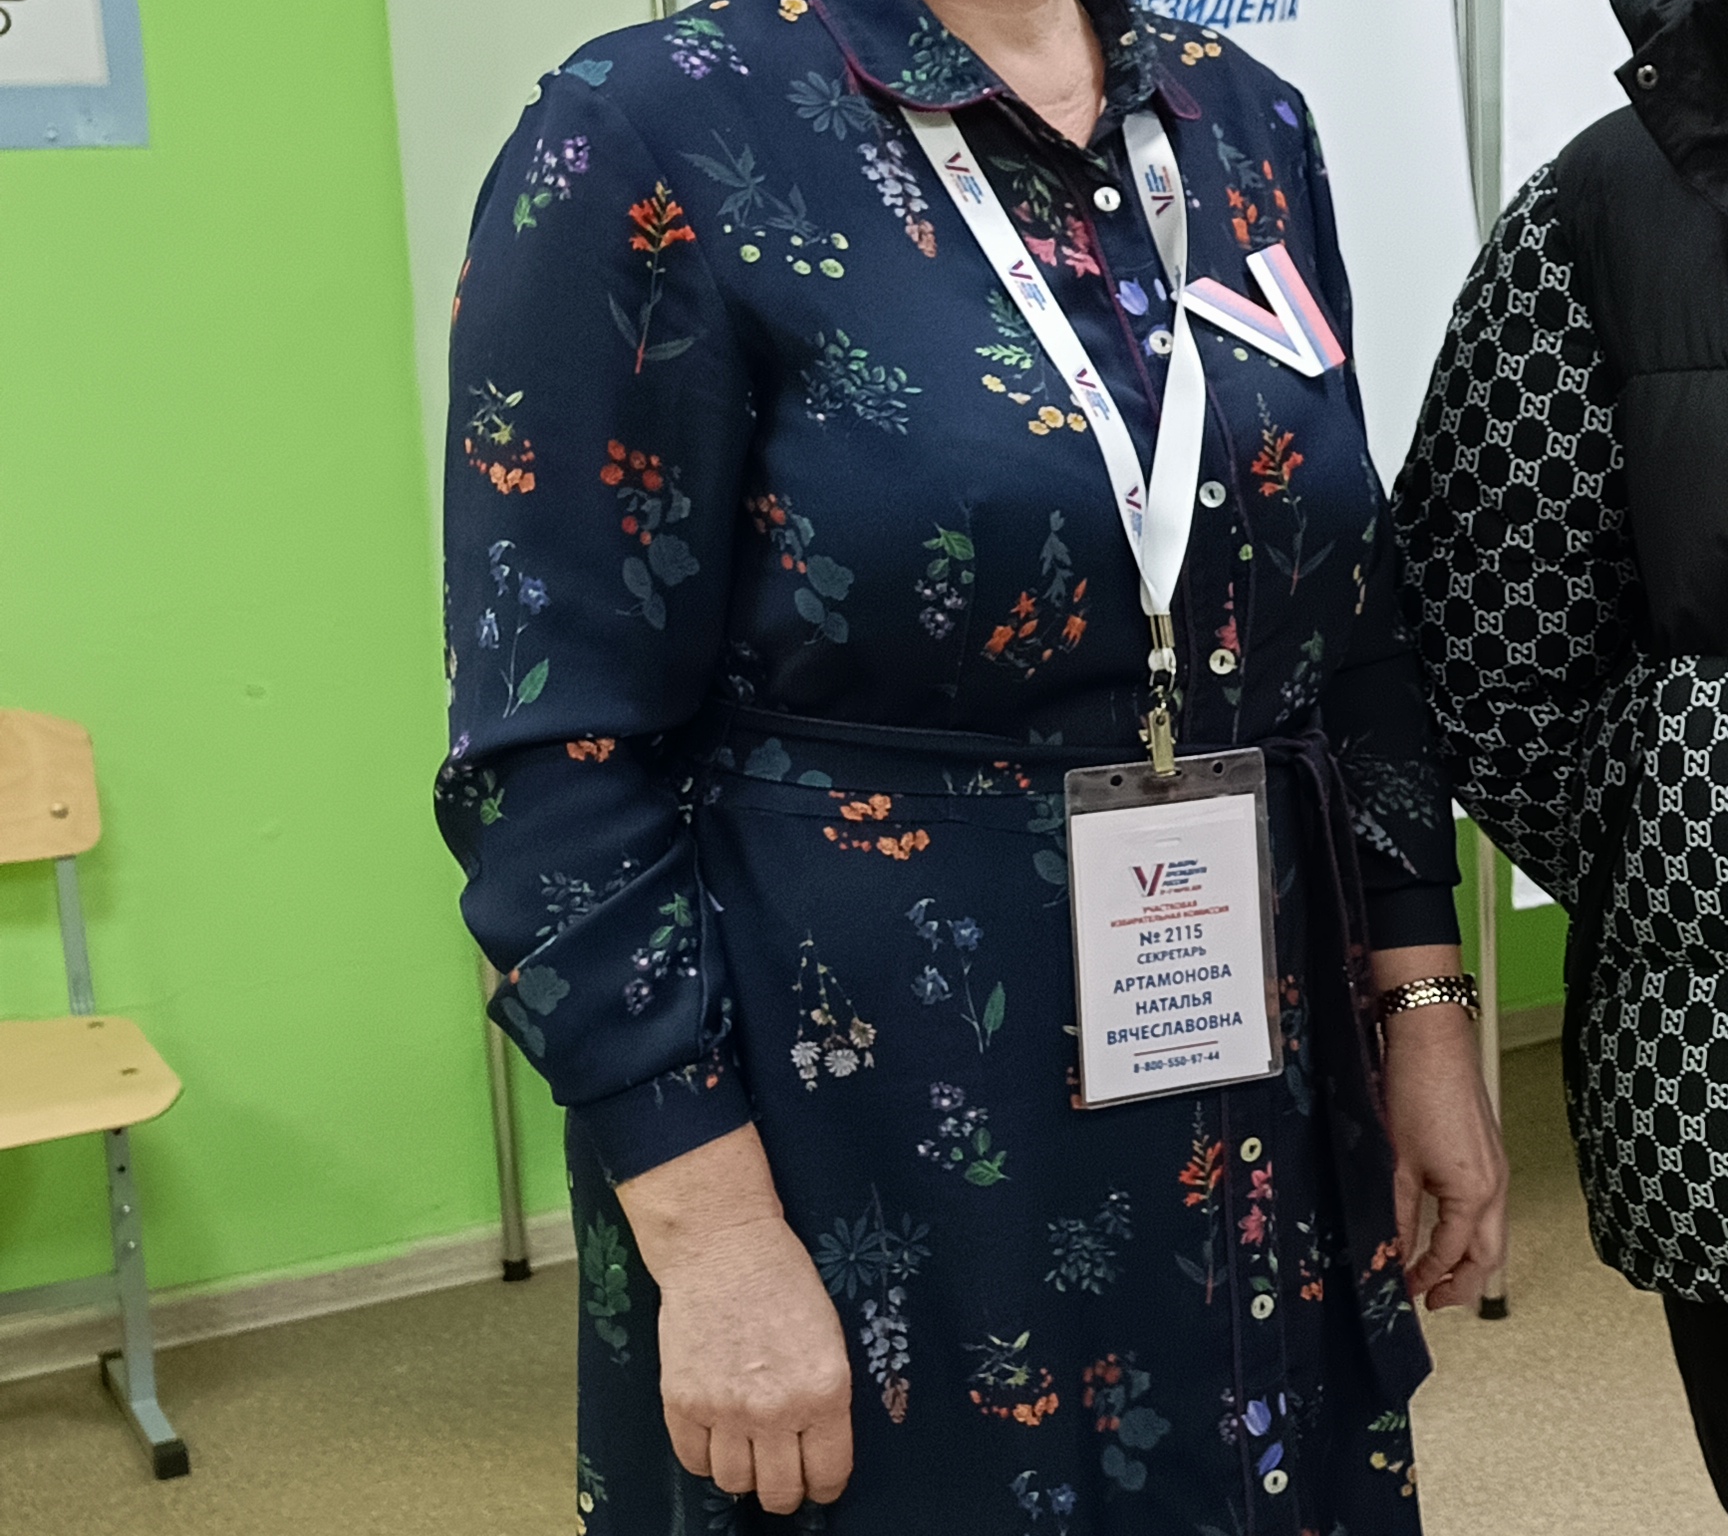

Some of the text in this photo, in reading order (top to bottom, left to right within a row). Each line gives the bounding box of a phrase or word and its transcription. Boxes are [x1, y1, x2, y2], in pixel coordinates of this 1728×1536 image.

[1139, 923, 1203, 946] № 2115
[1137, 946, 1207, 964] СЕКРЕТАРЬ
[1113, 964, 1232, 994] АРТАМОНОВА
[1135, 991, 1212, 1015] НАТАЛЬЯ
[1107, 1011, 1243, 1045] ВЯЧЕСЛАВОВНА
